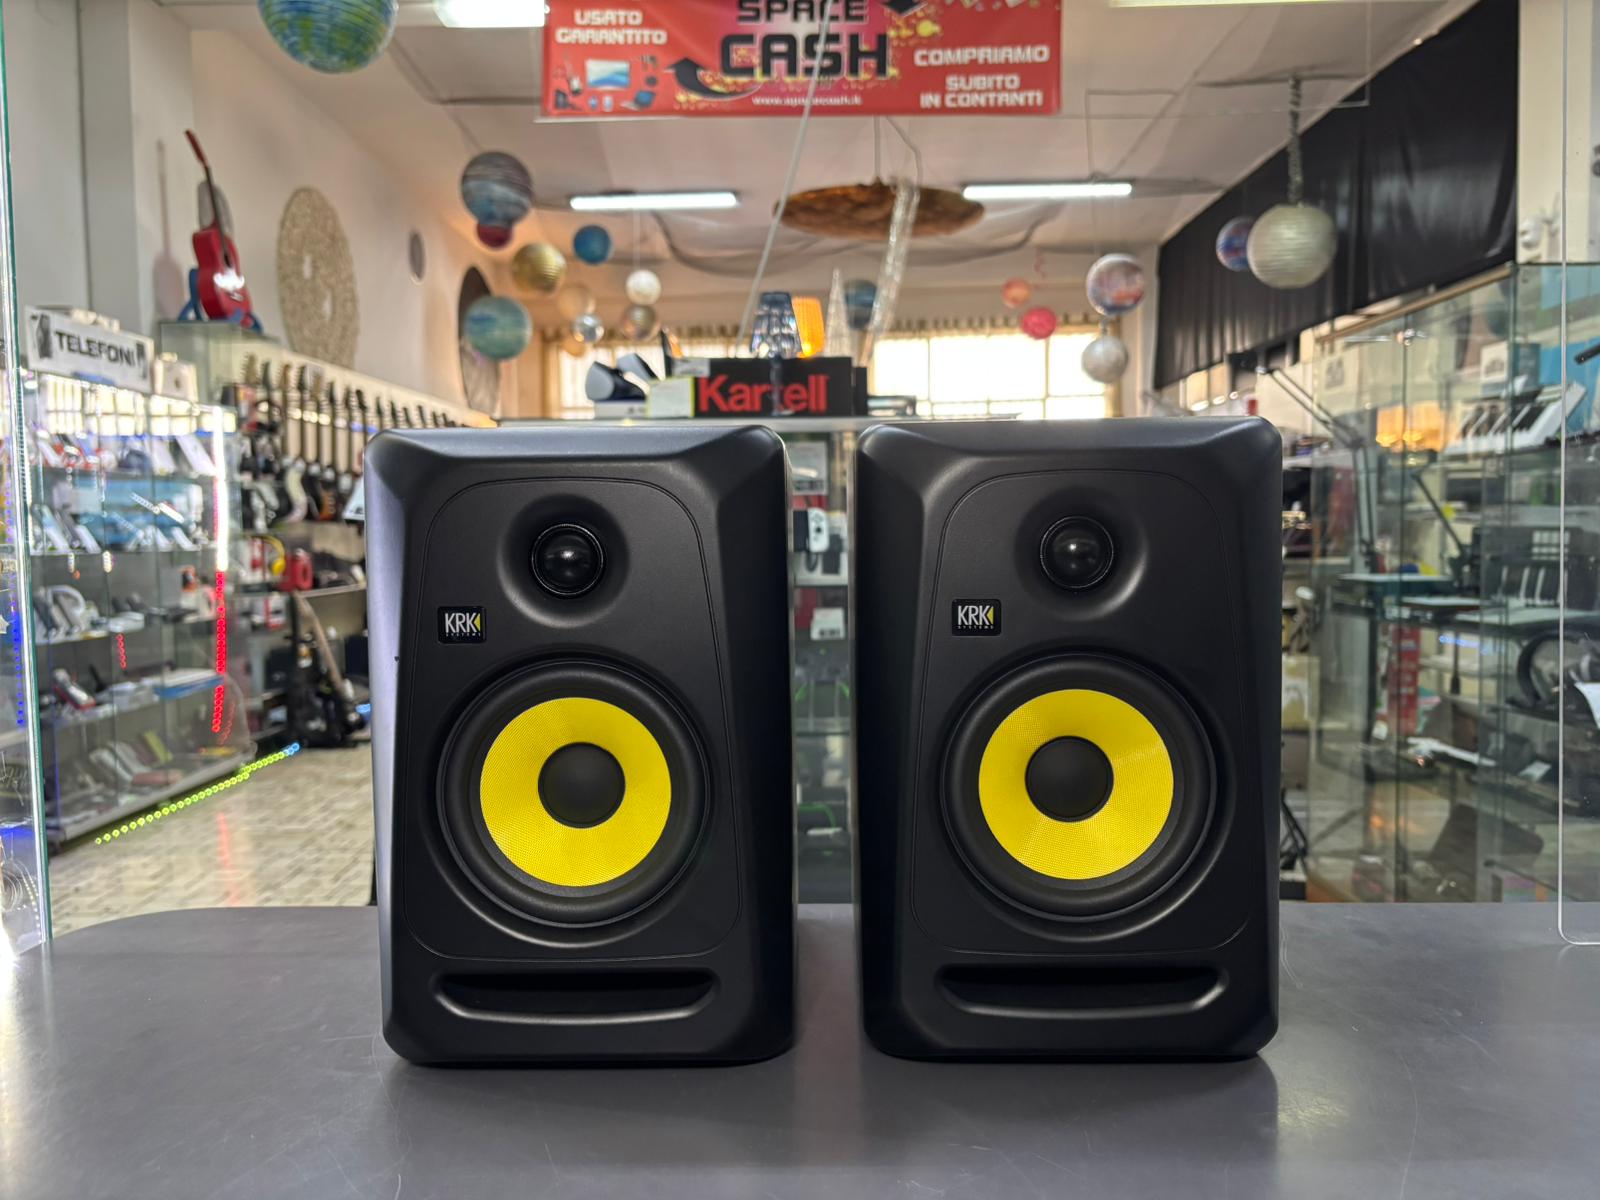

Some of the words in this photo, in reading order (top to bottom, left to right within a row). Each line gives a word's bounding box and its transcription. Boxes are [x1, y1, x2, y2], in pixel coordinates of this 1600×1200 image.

[574, 9, 643, 26] USATO
[738, 0, 864, 22] SPACE
[555, 28, 668, 44] GARANTITO
[721, 33, 888, 77] CASH
[914, 45, 1050, 66] COMPRIAMO
[945, 75, 1020, 91] SUBITO
[920, 93, 942, 108] IN
[944, 90, 1043, 107] CONTANTI
[55, 330, 137, 366] TELEFONI
[698, 375, 828, 413] Karell
[444, 612, 478, 633] KRK
[957, 605, 991, 626] KRK
